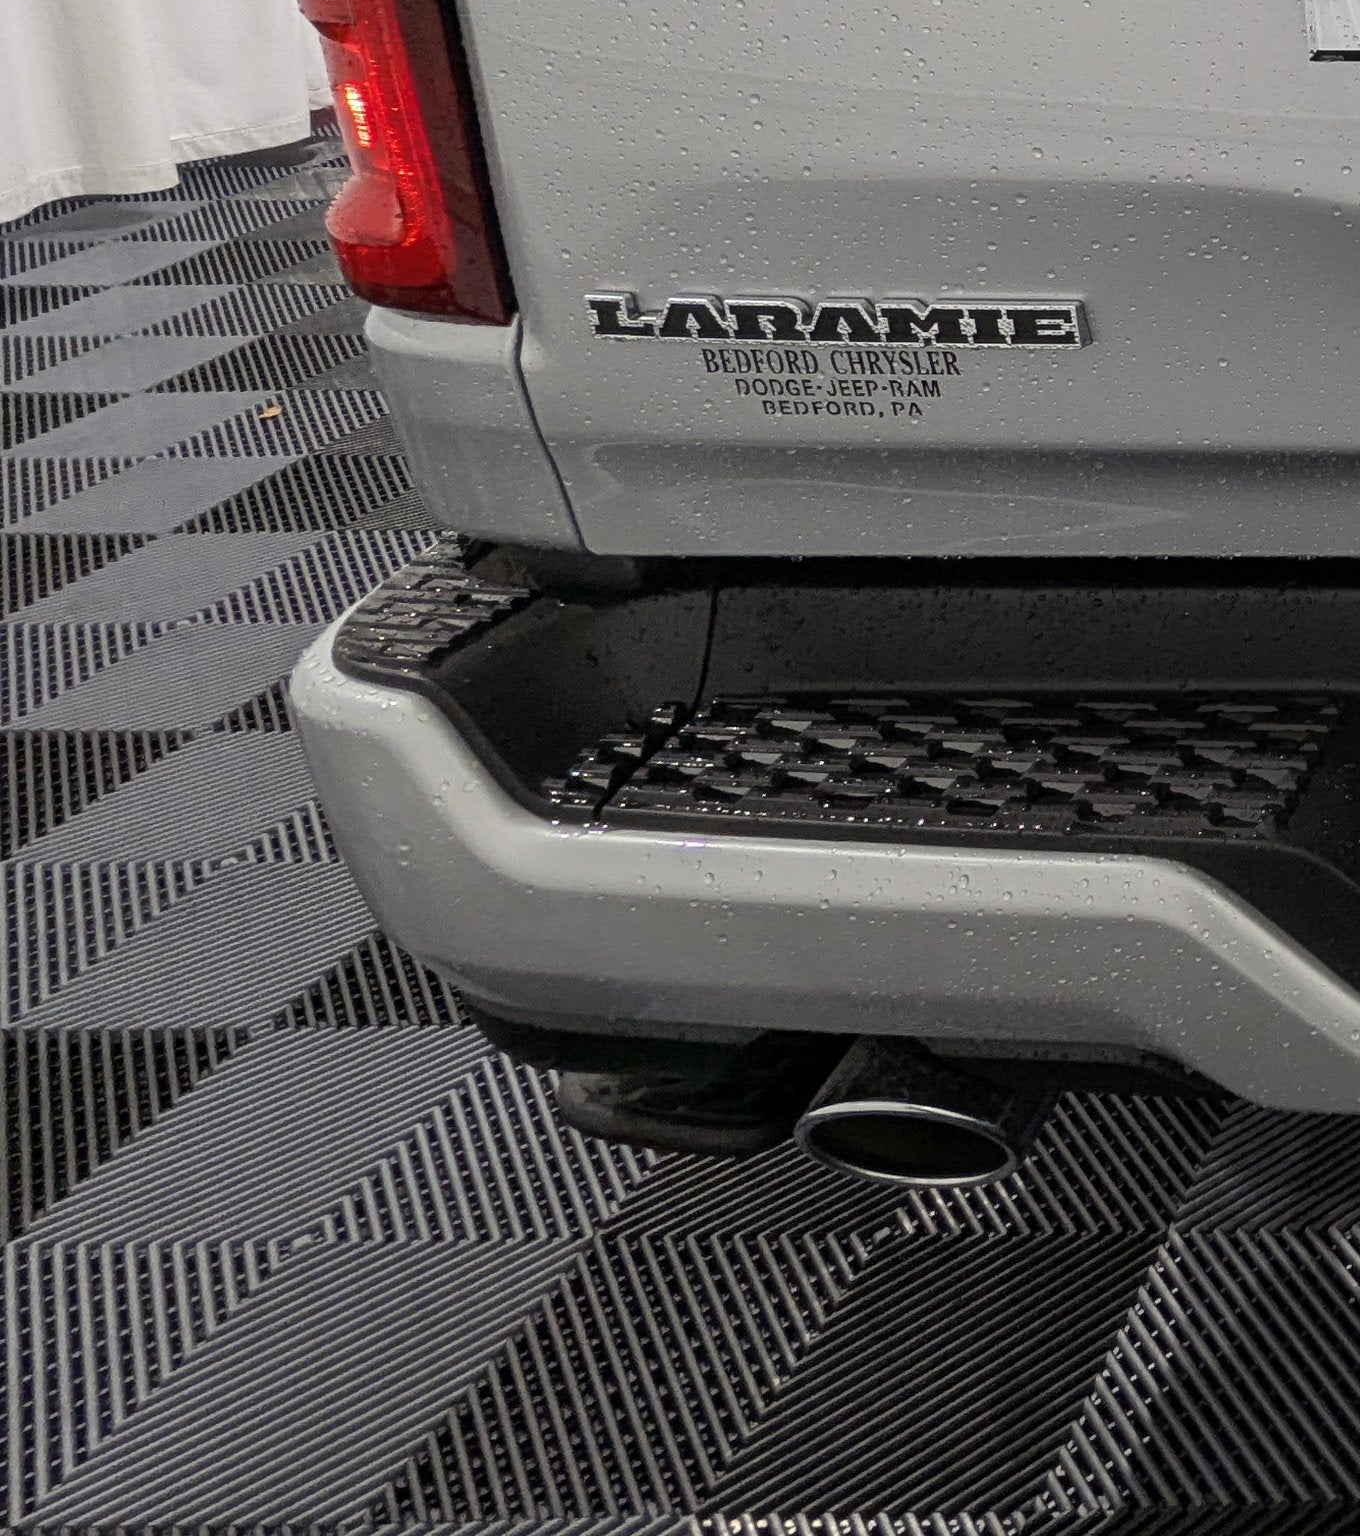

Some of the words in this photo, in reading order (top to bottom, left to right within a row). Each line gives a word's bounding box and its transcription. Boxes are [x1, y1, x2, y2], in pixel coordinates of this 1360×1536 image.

[583, 291, 1092, 350] LARAMIE
[701, 349, 818, 375] BEDFORD
[832, 350, 962, 376] CHRYSLER
[762, 400, 884, 418] BEDFORD,
[892, 402, 924, 417] PA
